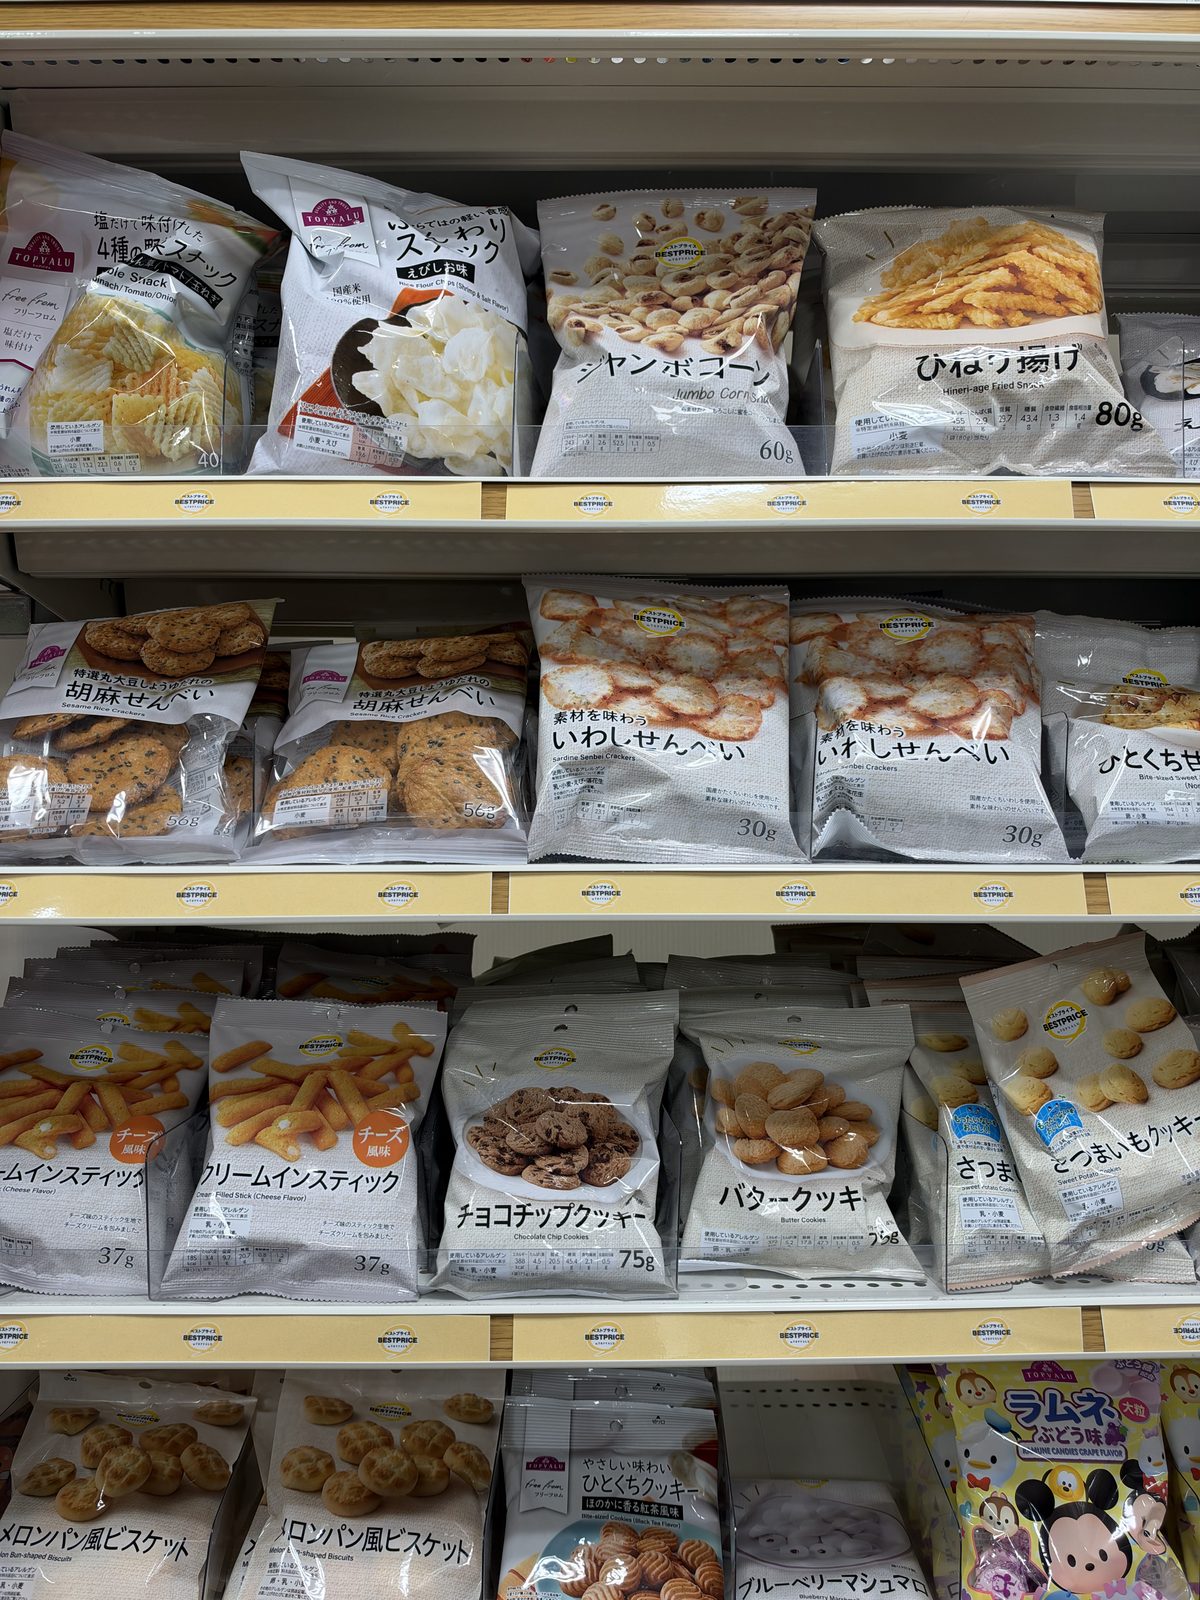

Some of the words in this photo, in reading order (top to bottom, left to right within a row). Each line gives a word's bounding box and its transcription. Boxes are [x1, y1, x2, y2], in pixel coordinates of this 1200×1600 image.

[307, 211, 361, 224] TOPVALU
[94, 211, 202, 243] 塩だけで味付けした
[15, 253, 71, 268] TOPVALU
[655, 249, 706, 258] BESTPRICE
[408, 261, 468, 279] えびしお味
[130, 271, 168, 289] Snack
[332, 283, 362, 297] 国産米
[456, 281, 476, 298] (Shrimp
[481, 294, 491, 304] Salt
[2, 288, 27, 308] free
[28, 290, 60, 311] from
[15, 307, 58, 322] フリーフロム
[3, 326, 43, 342] 塩だけで
[5, 339, 34, 353] 味付け
[577, 351, 770, 387] ジャンボコーン
[916, 345, 1082, 382] ひねり揚げ
[673, 389, 715, 402] Jumbo
[721, 387, 750, 401] Corn
[942, 383, 990, 396] Hineri-age
[991, 382, 1015, 392] Fried
[1021, 414, 1038, 424] 43.4
[1049, 414, 1060, 422] 1.3
[1074, 413, 1086, 421] 1.4
[1095, 401, 1144, 432] 80g
[308, 435, 338, 448] 小麦・えび
[890, 431, 908, 442] 小麦
[760, 440, 794, 464] 60g
[198, 455, 220, 468] 40
[633, 613, 685, 628] BESTPRICE
[73, 668, 213, 692] 特選丸大豆しょうゆだれの
[363, 676, 496, 699] 特選丸大豆しょうゆだれの
[65, 680, 214, 712] 胡麻せんべい
[357, 686, 501, 713] 胡麻せんべい
[61, 702, 92, 710] Sesame
[93, 704, 111, 712] Rice
[112, 706, 146, 717] Crackers
[354, 711, 384, 719] Sesame
[402, 710, 434, 720] Crackers
[553, 709, 648, 726] 素材を味わう
[819, 719, 904, 746] 素材を味わう
[553, 725, 746, 762] いわしせんべい
[816, 737, 1010, 765] いわしせんべい
[552, 755, 579, 763] Sardine
[605, 753, 636, 762] Crackers
[866, 764, 898, 772] Crackers
[463, 801, 497, 820] 56g
[167, 815, 201, 828] 56g
[737, 818, 778, 842] 30g
[1002, 825, 1043, 848] 30g
[1042, 1009, 1089, 1033] BESTPRICE
[299, 1042, 344, 1050] BESTPRICE
[69, 1054, 114, 1064] BESTPRICE
[116, 1128, 160, 1144] チーズ
[358, 1126, 404, 1145] チーズ
[121, 1143, 148, 1156] 風味
[366, 1145, 391, 1158] 風味
[0, 1162, 144, 1189] ームインスティック
[201, 1163, 401, 1194] クリームインスティック
[1058, 1176, 1078, 1186] Sweet
[1079, 1172, 1099, 1182] Potato
[2, 1186, 31, 1194] (Cheese
[215, 1191, 235, 1199] Filled
[235, 1192, 252, 1200] Stick
[253, 1192, 282, 1201] (Cheese
[282, 1194, 307, 1202] Flavor)
[1061, 1180, 1117, 1199] 使用しているアレルゲン
[718, 1182, 867, 1213] バタークッキ
[962, 1196, 1015, 1204] 使用しているアレルゲン
[69, 1213, 142, 1224] チーズ味のスティック生地で
[457, 1202, 646, 1229] チョコチップクッキー
[780, 1216, 800, 1224] Butter
[801, 1216, 826, 1224] Cookies
[979, 1210, 1005, 1218] 乳・小麦
[64, 1221, 140, 1234] チーズクリームを包みました。
[323, 1220, 395, 1231] チーズ味のスティック生地で
[318, 1229, 394, 1241] チーズクリームを包みました。
[513, 1233, 546, 1241] Chocolate
[547, 1233, 562, 1241] Chip
[563, 1233, 589, 1241] Cookies
[704, 1231, 760, 1241] 使用しているアレルゲン
[98, 1246, 135, 1269] 37g
[449, 1251, 507, 1259] 使用しているアレルゲン
[618, 1250, 655, 1272] 75g
[353, 1255, 391, 1276] 37g
[1025, 1371, 1074, 1381] TOPVALU
[370, 1406, 413, 1416] BESTPRICE
[1007, 1390, 1117, 1426] ラムネ
[1122, 1401, 1146, 1418] 大粒
[1037, 1426, 1103, 1446] ぶどう味
[1022, 1447, 1051, 1456] RAMUNE
[1052, 1448, 1079, 1457] CANDIES
[1079, 1449, 1099, 1457] GRAPE
[1100, 1450, 1123, 1459] FLAVOR
[582, 1458, 671, 1475] やさしい味わい
[582, 1473, 699, 1502] ひとくちクッキー
[585, 1498, 680, 1518] ほのかに香る紅茶風味
[610, 1515, 632, 1523] Cookies
[633, 1517, 650, 1525] (Black
[661, 1520, 681, 1529] Flavor)
[0, 1523, 189, 1562] メロンパン風ビスケット
[9, 1551, 47, 1560] Bun-shaped
[47, 1553, 73, 1562] Biscuits
[328, 1551, 355, 1562] Biscuits
[738, 1572, 929, 1600] ブルーベリーマシュマロ
